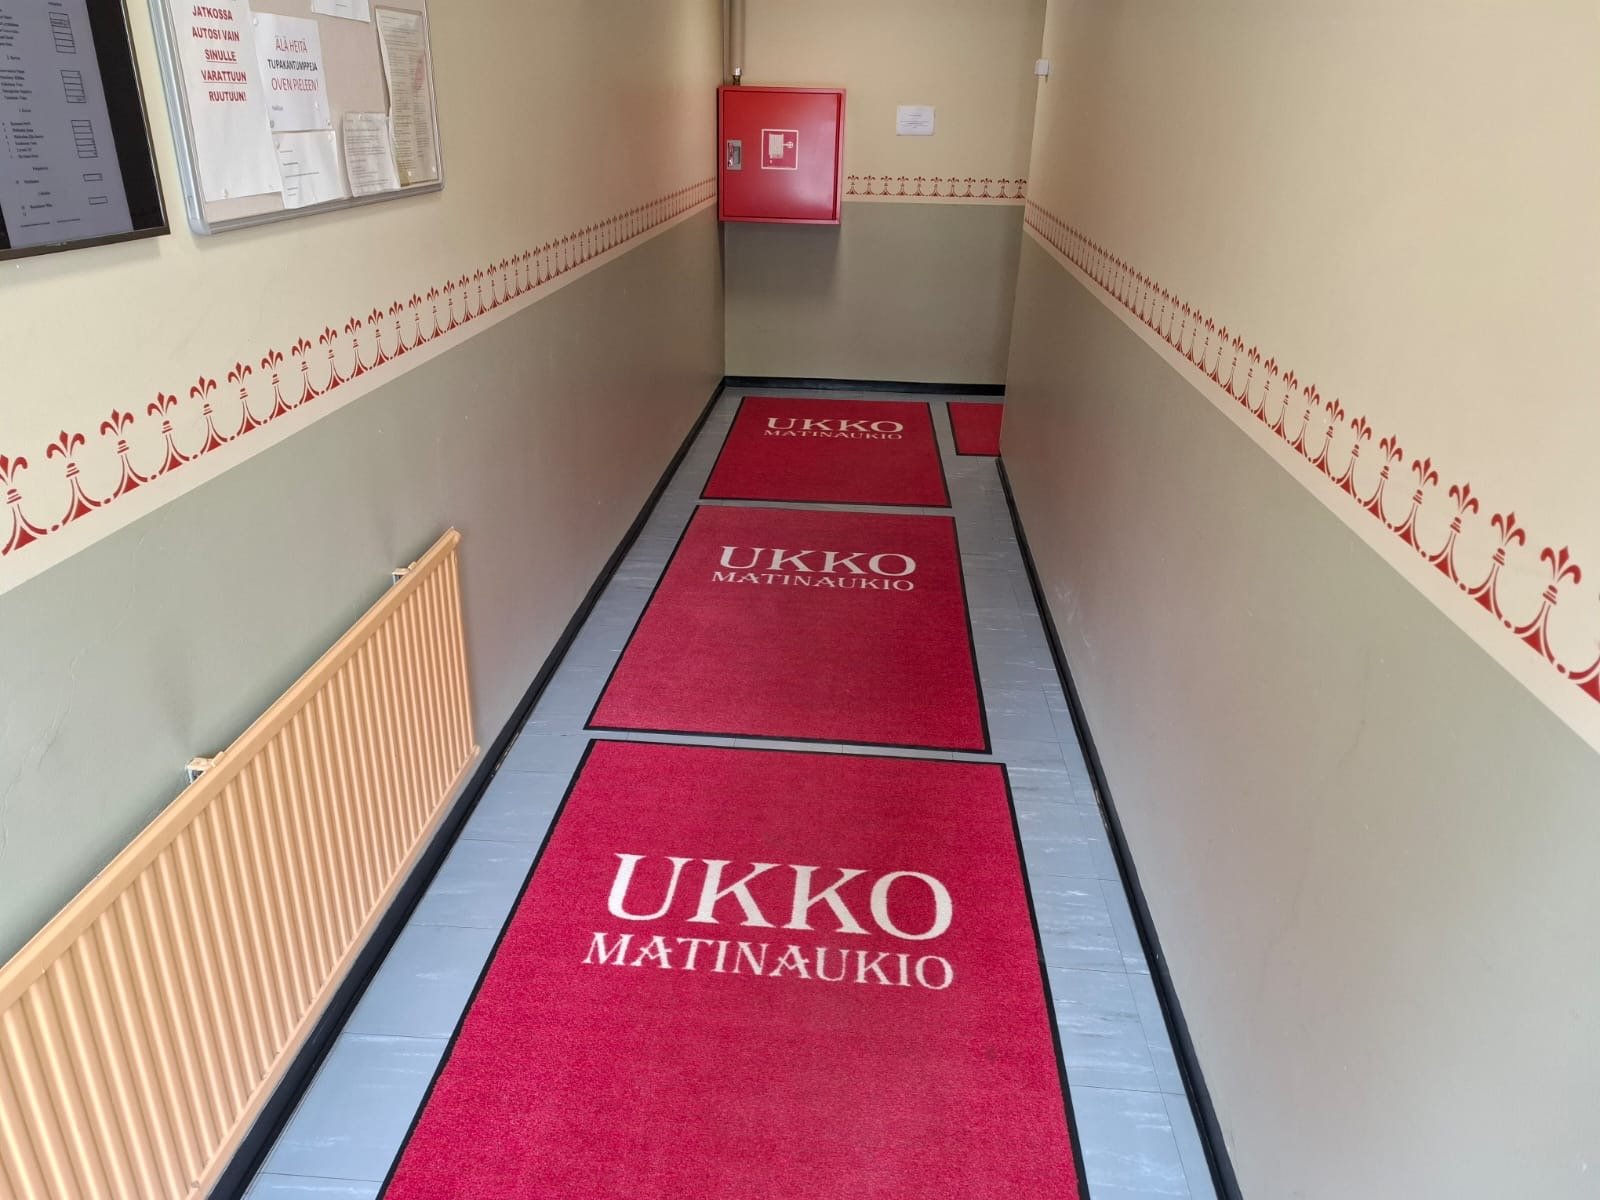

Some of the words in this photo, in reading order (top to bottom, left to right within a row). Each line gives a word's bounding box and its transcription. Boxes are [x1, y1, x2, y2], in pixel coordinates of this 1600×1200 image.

[192, 5, 234, 21] JATKOSSA
[192, 26, 222, 40] AUTOSI
[222, 29, 240, 42] VAIN
[205, 48, 237, 62] SINULLE
[201, 69, 247, 82] VARATTUUN
[271, 78, 293, 91] OVEN
[208, 91, 247, 102] RUUTUUN!
[767, 417, 904, 433] UKKO
[764, 429, 903, 440] MATINAUKIO
[719, 545, 917, 577] UKKO
[711, 571, 915, 592] MATINAUKIO
[607, 852, 954, 941] UKKO
[581, 931, 955, 991] MATINAUKIO
